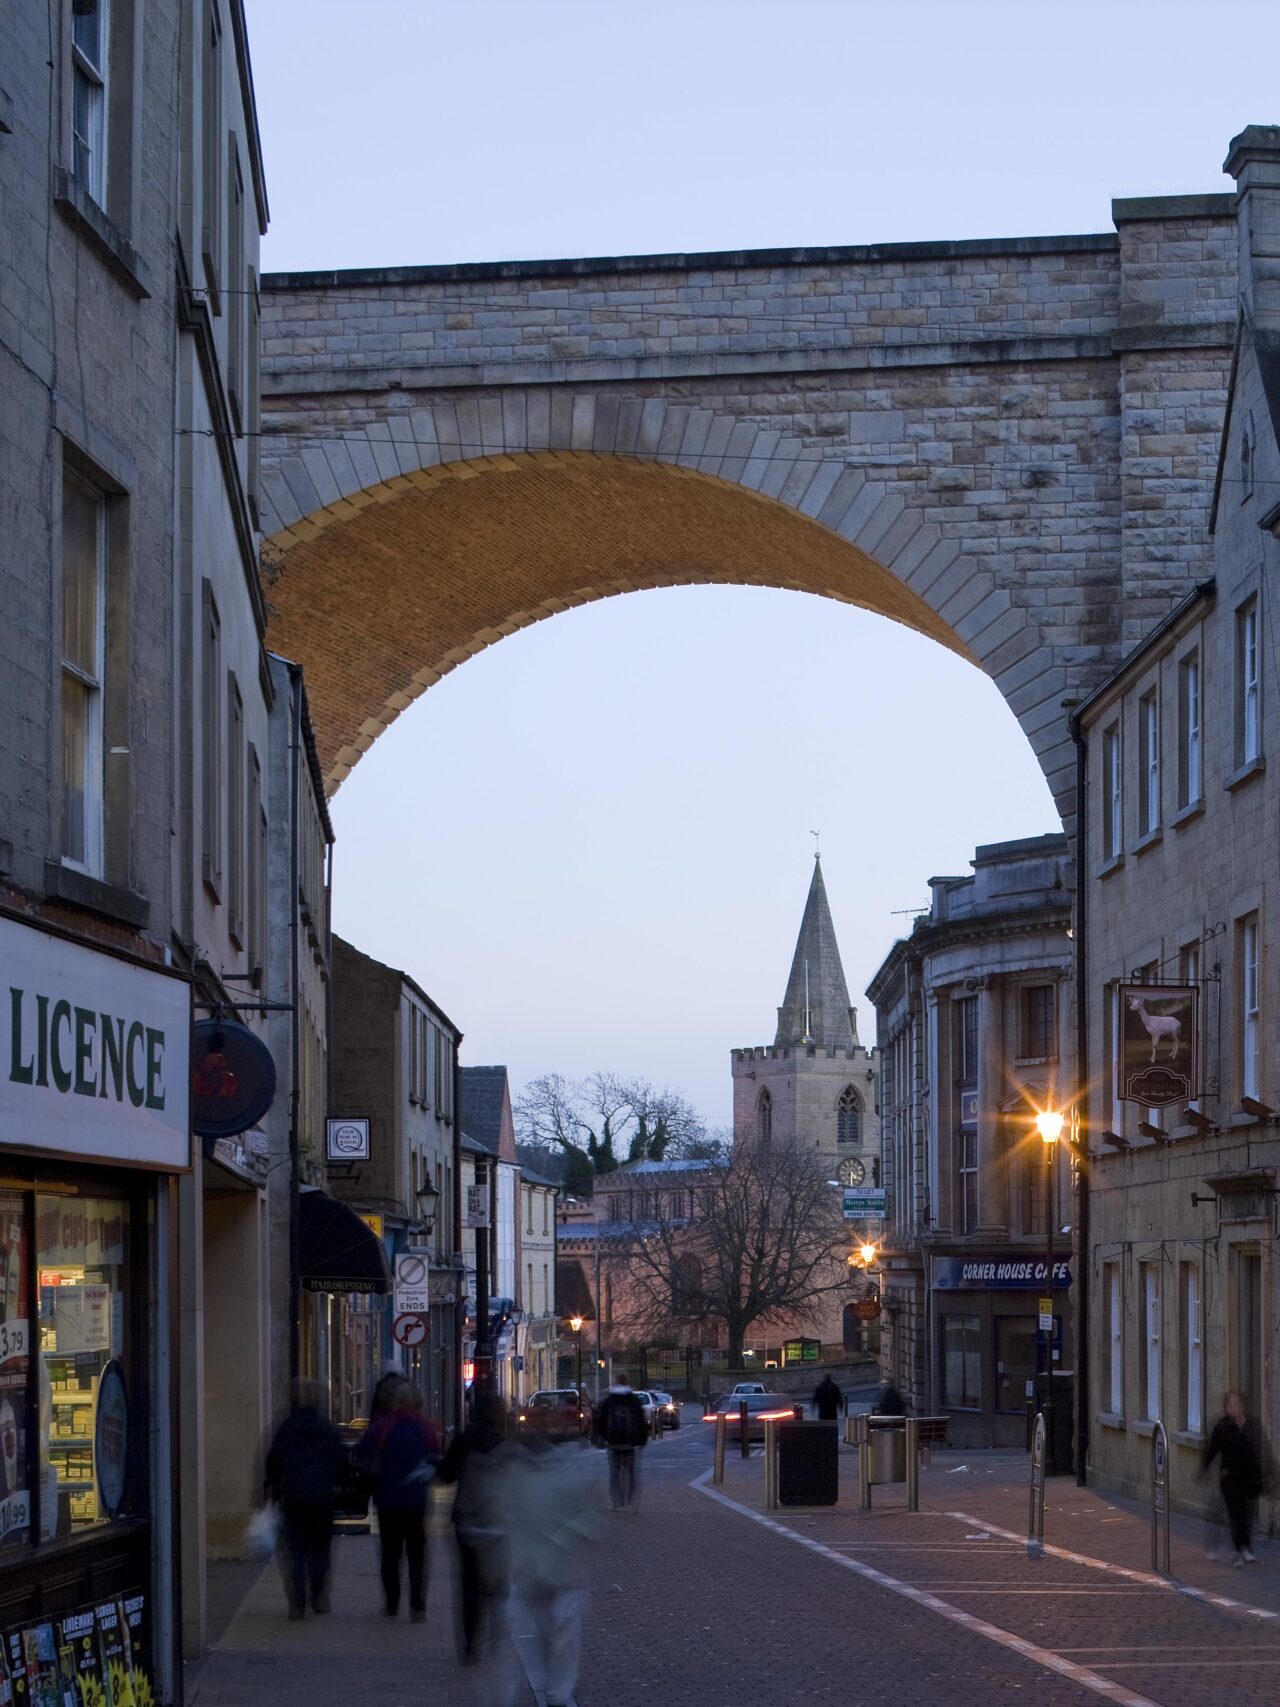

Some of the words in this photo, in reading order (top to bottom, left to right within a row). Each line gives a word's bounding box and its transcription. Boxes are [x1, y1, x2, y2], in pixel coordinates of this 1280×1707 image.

[9, 986, 166, 1111] LICENCE
[963, 1263, 995, 1279] CORNER
[997, 1263, 1034, 1280] HOUSE
[400, 1302, 425, 1310] ENDS
[0, 1327, 23, 1358] 3.79
[0, 1501, 26, 1535] 10.99
